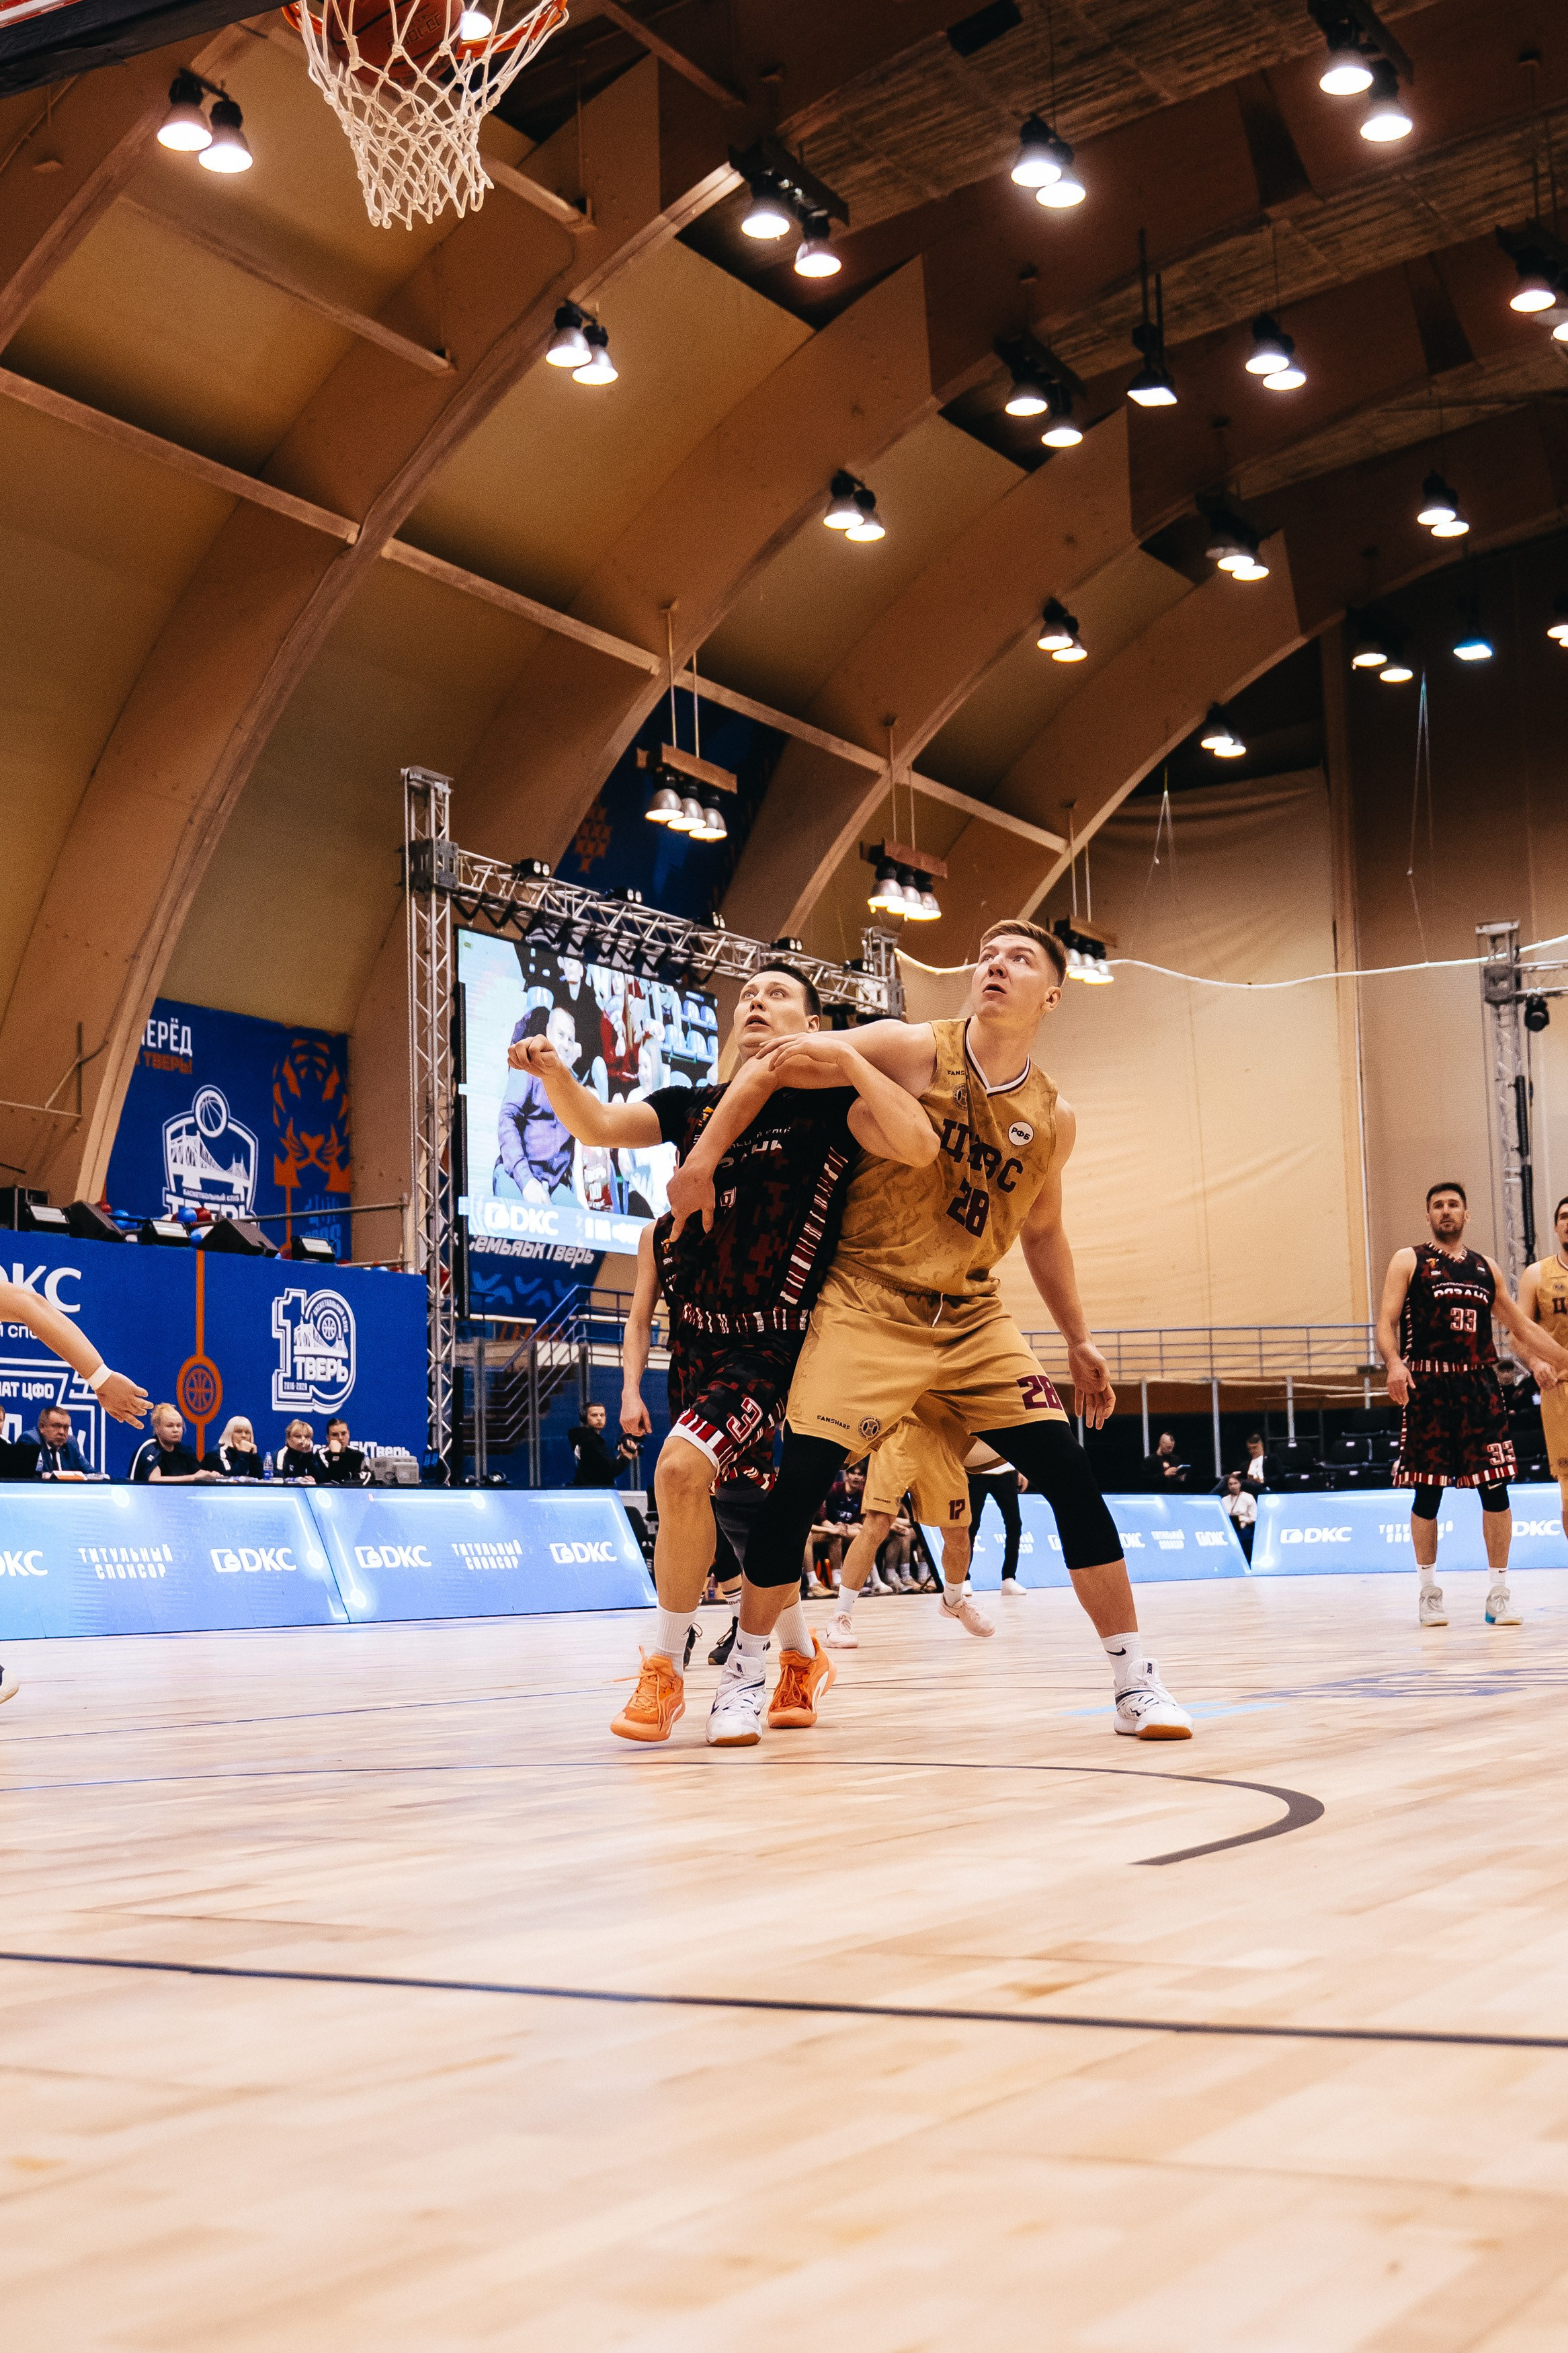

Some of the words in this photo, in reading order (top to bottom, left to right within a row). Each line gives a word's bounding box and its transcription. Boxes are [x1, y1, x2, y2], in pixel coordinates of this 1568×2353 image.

[141, 1017, 193, 1058] ЕРЁД
[1011, 1127, 1030, 1140] РФБ
[510, 1207, 559, 1236] DKC
[0, 1263, 82, 1313] KC
[1450, 1307, 1477, 1332] 33
[293, 1357, 349, 1383] ТВЕРЬ
[22, 1382, 54, 1401] ЦФО
[1016, 1375, 1063, 1411] 28
[1487, 1439, 1516, 1466] 33
[1304, 1527, 1353, 1543] DKC
[78, 1544, 173, 1564] ТИТУЛЬНЫЙ
[238, 1547, 297, 1572] DKC
[379, 1545, 432, 1568] DKC
[452, 1539, 523, 1556] ТИТУЛЬНЫЙ
[569, 1542, 618, 1564] DKC
[0, 1550, 48, 1577] KC
[95, 1563, 167, 1580] СПОНСОР
[466, 1555, 520, 1570] СПОНСОР
